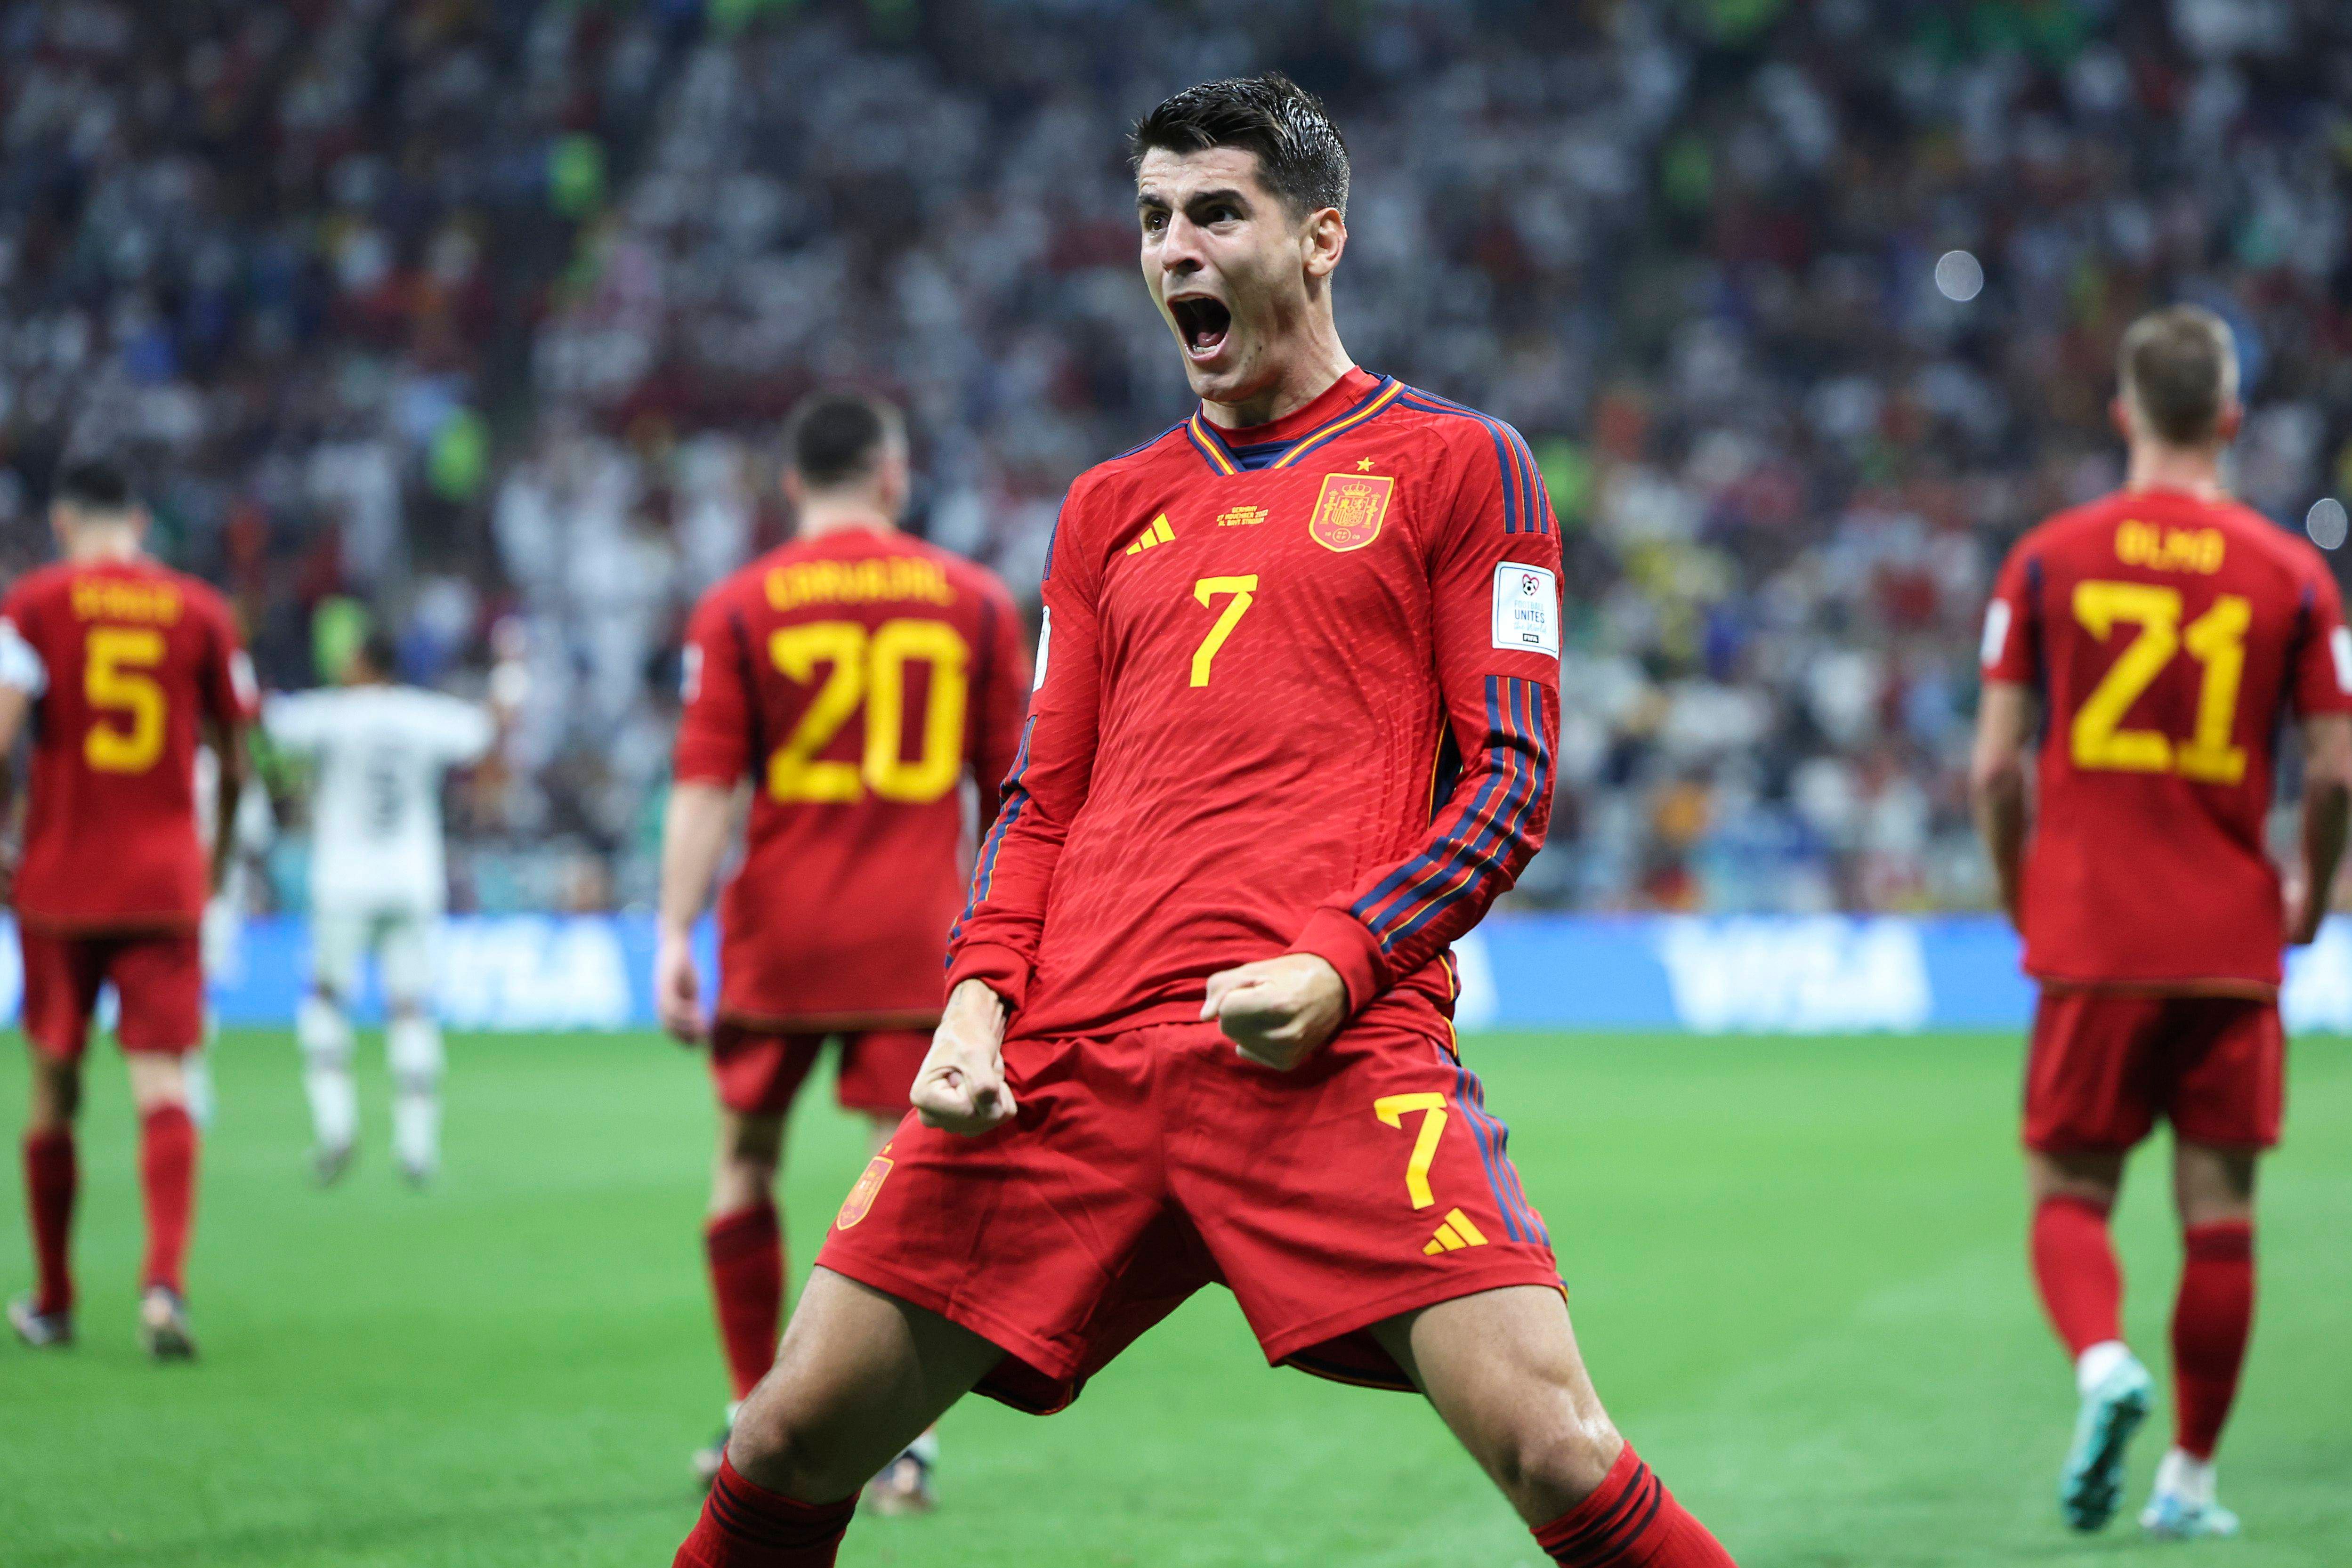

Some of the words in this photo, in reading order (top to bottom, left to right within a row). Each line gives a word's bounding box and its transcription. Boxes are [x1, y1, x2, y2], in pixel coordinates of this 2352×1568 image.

[1189, 574, 1259, 687] 7
[1515, 609, 1545, 623] UNITES
[2072, 579, 2252, 785] 21
[84, 627, 167, 773] 5
[767, 619, 969, 803] 20
[1374, 1092, 1448, 1210] 7
